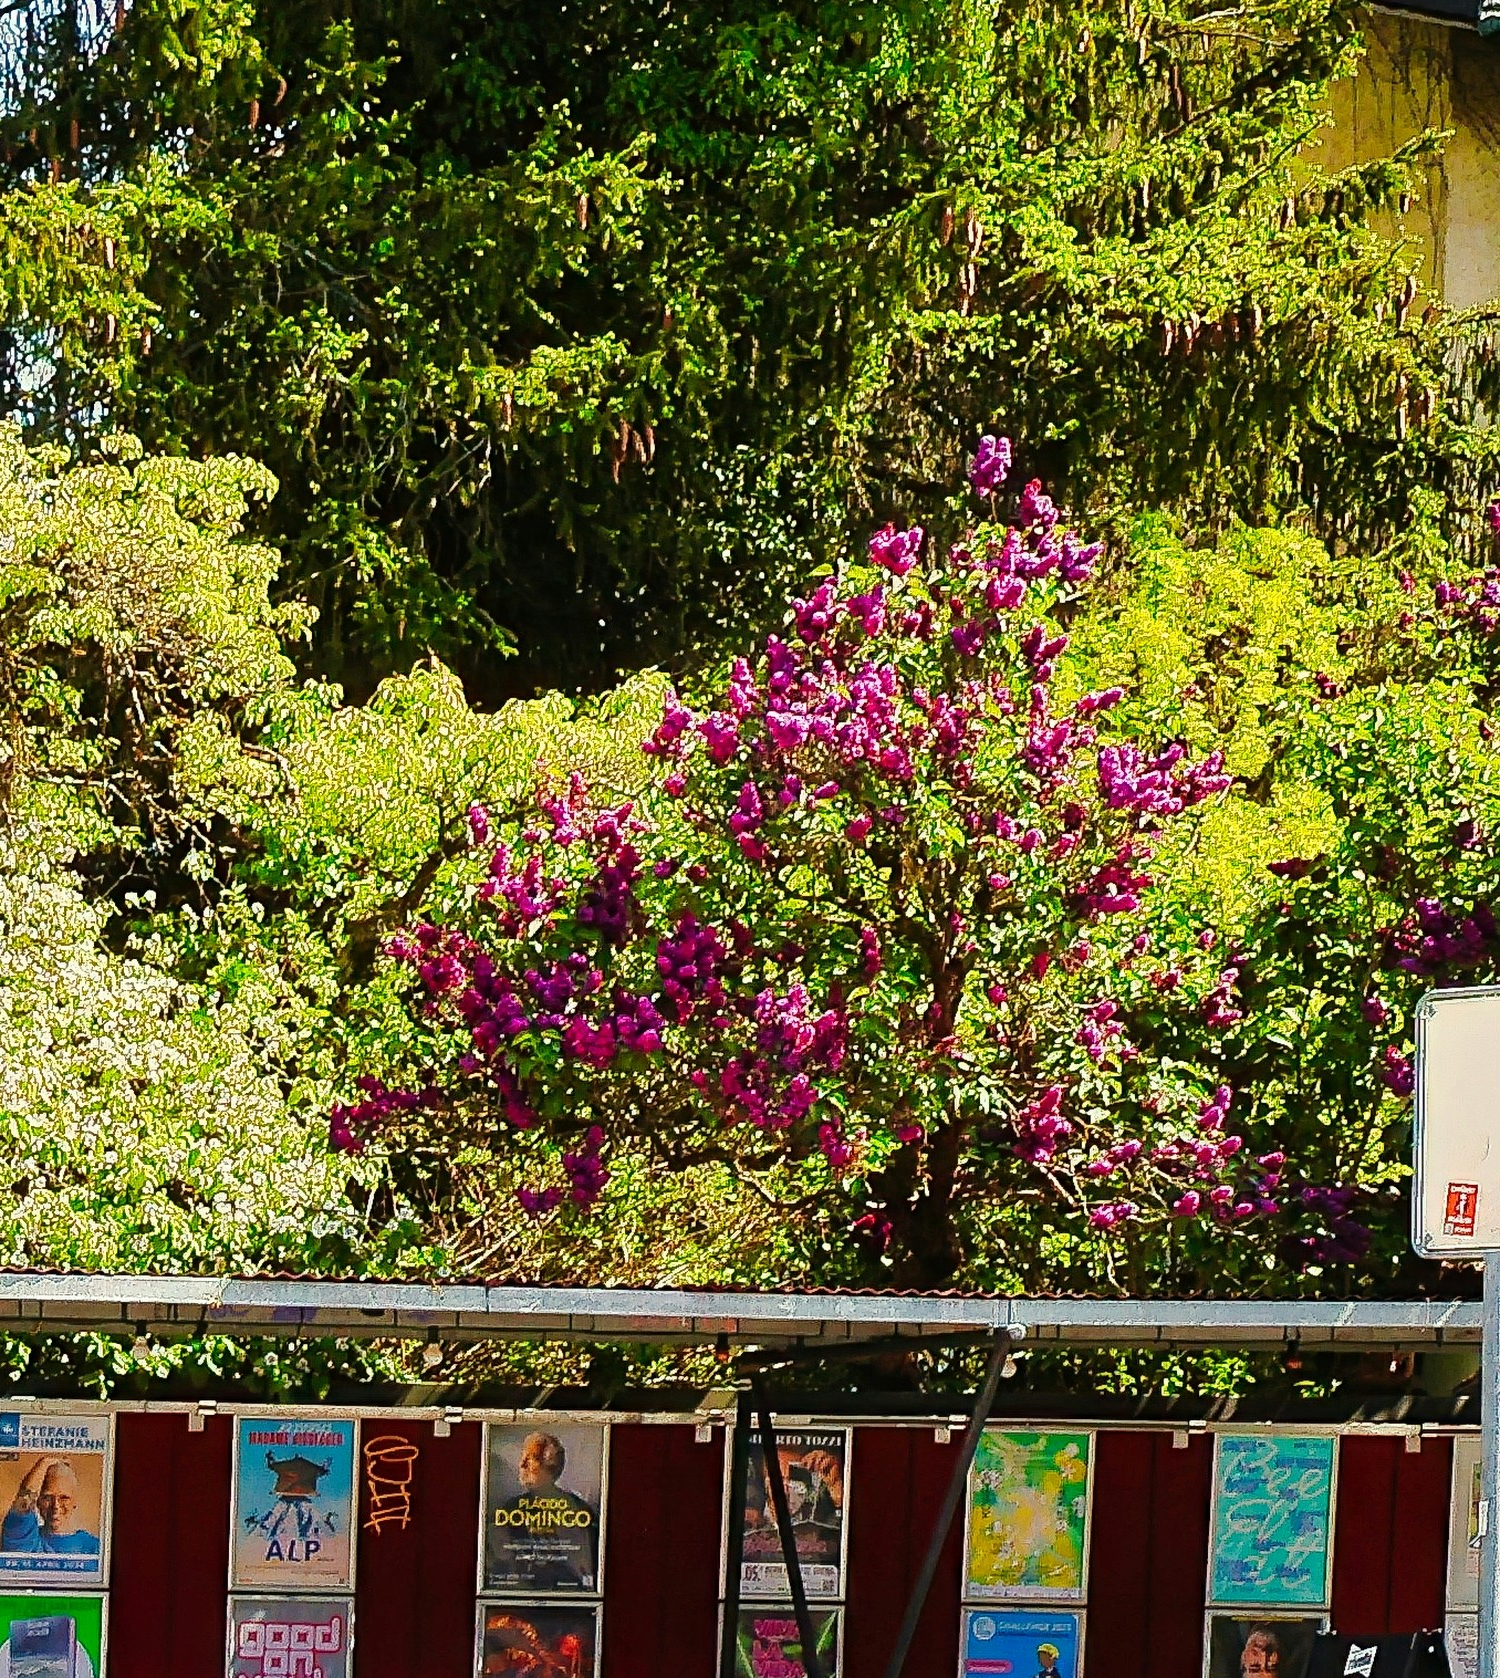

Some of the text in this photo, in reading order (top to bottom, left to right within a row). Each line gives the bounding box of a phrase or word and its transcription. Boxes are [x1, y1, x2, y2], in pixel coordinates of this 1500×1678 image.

[494, 1509, 591, 1528] DOMINGO
[266, 1540, 321, 1562] ALP
[239, 1617, 341, 1658] good
[263, 1650, 315, 1676] on
